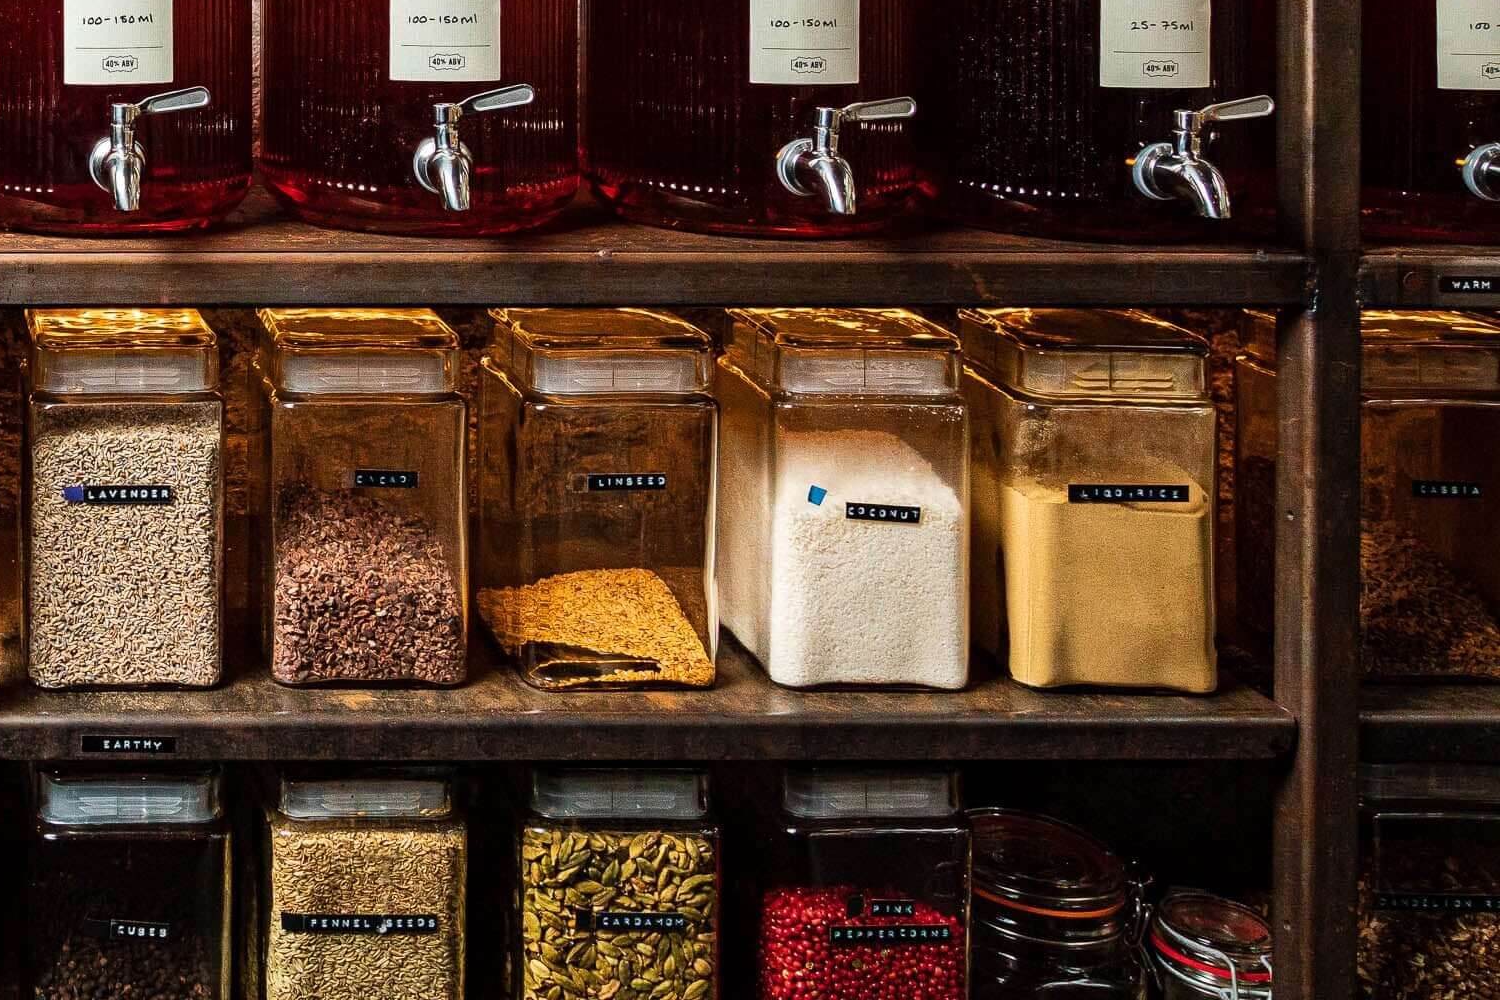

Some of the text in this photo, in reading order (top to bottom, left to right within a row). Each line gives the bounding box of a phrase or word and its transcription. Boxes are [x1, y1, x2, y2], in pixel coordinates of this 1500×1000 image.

[432, 58, 462, 66] 40% ABV
[811, 61, 823, 69] ABV
[1451, 280, 1491, 290] WARM
[598, 476, 666, 487] LINSEED
[87, 488, 170, 500] LAVENDER
[1420, 485, 1480, 495] CASSIA
[848, 506, 919, 520] COCONUT
[103, 740, 162, 750] EARTHY
[872, 904, 913, 915] PINK
[310, 918, 436, 928] FENNEL SEEDS
[602, 917, 685, 927] CARDAMOM
[834, 928, 950, 940] PEPPERCORNS
